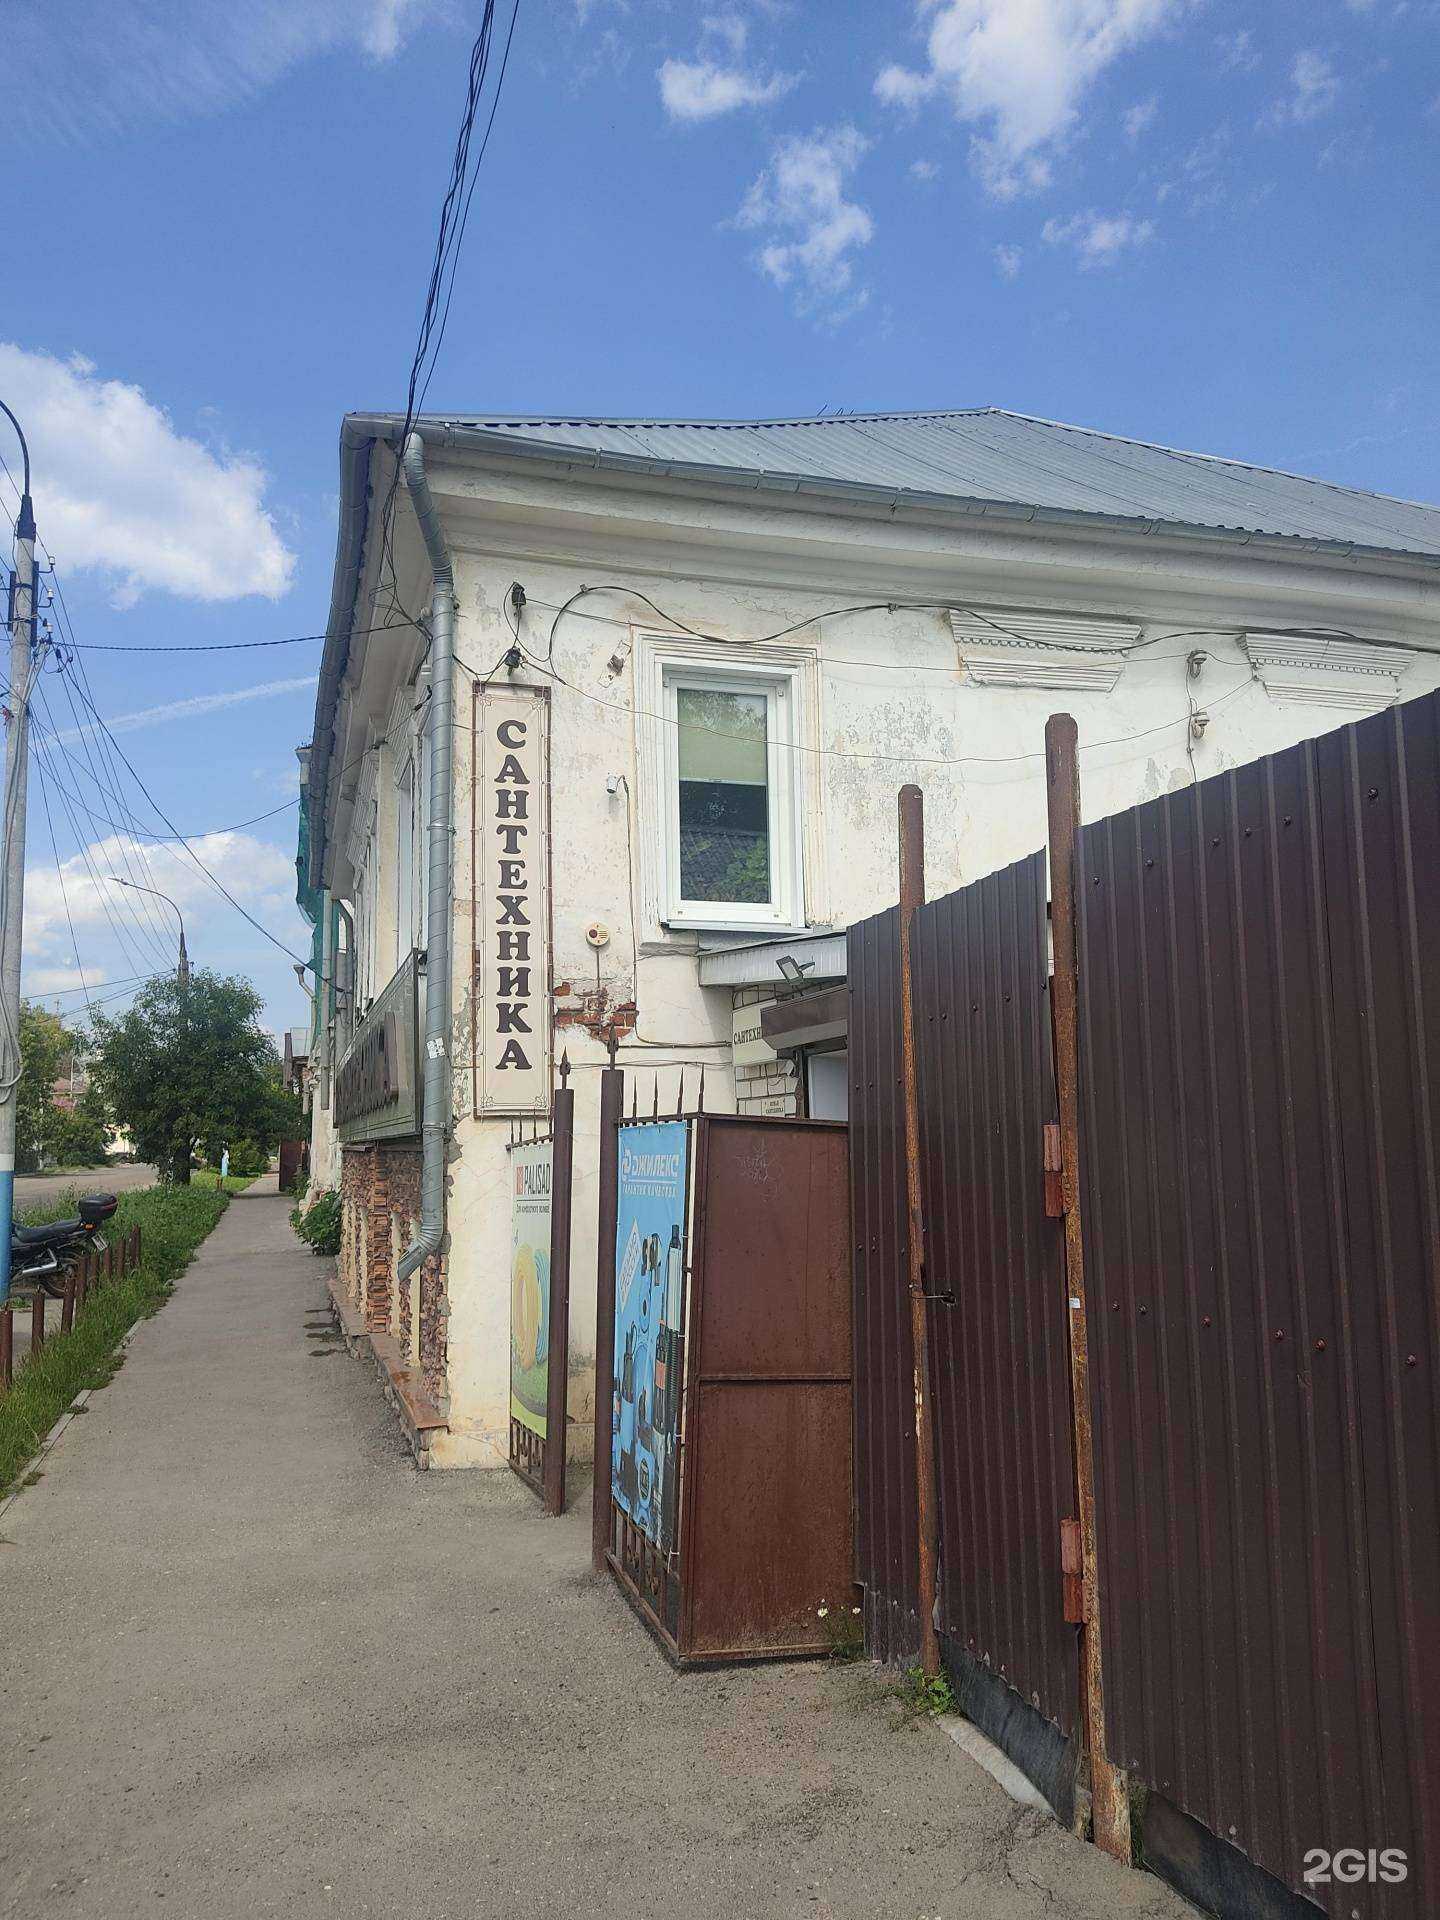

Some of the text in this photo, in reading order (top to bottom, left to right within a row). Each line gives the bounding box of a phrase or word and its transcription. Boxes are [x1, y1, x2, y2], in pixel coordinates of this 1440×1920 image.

[494, 719, 533, 1071] САНТЕХНИКА
[733, 1026, 762, 1045] САНТЕХН
[524, 1163, 551, 1195] PALISAD
